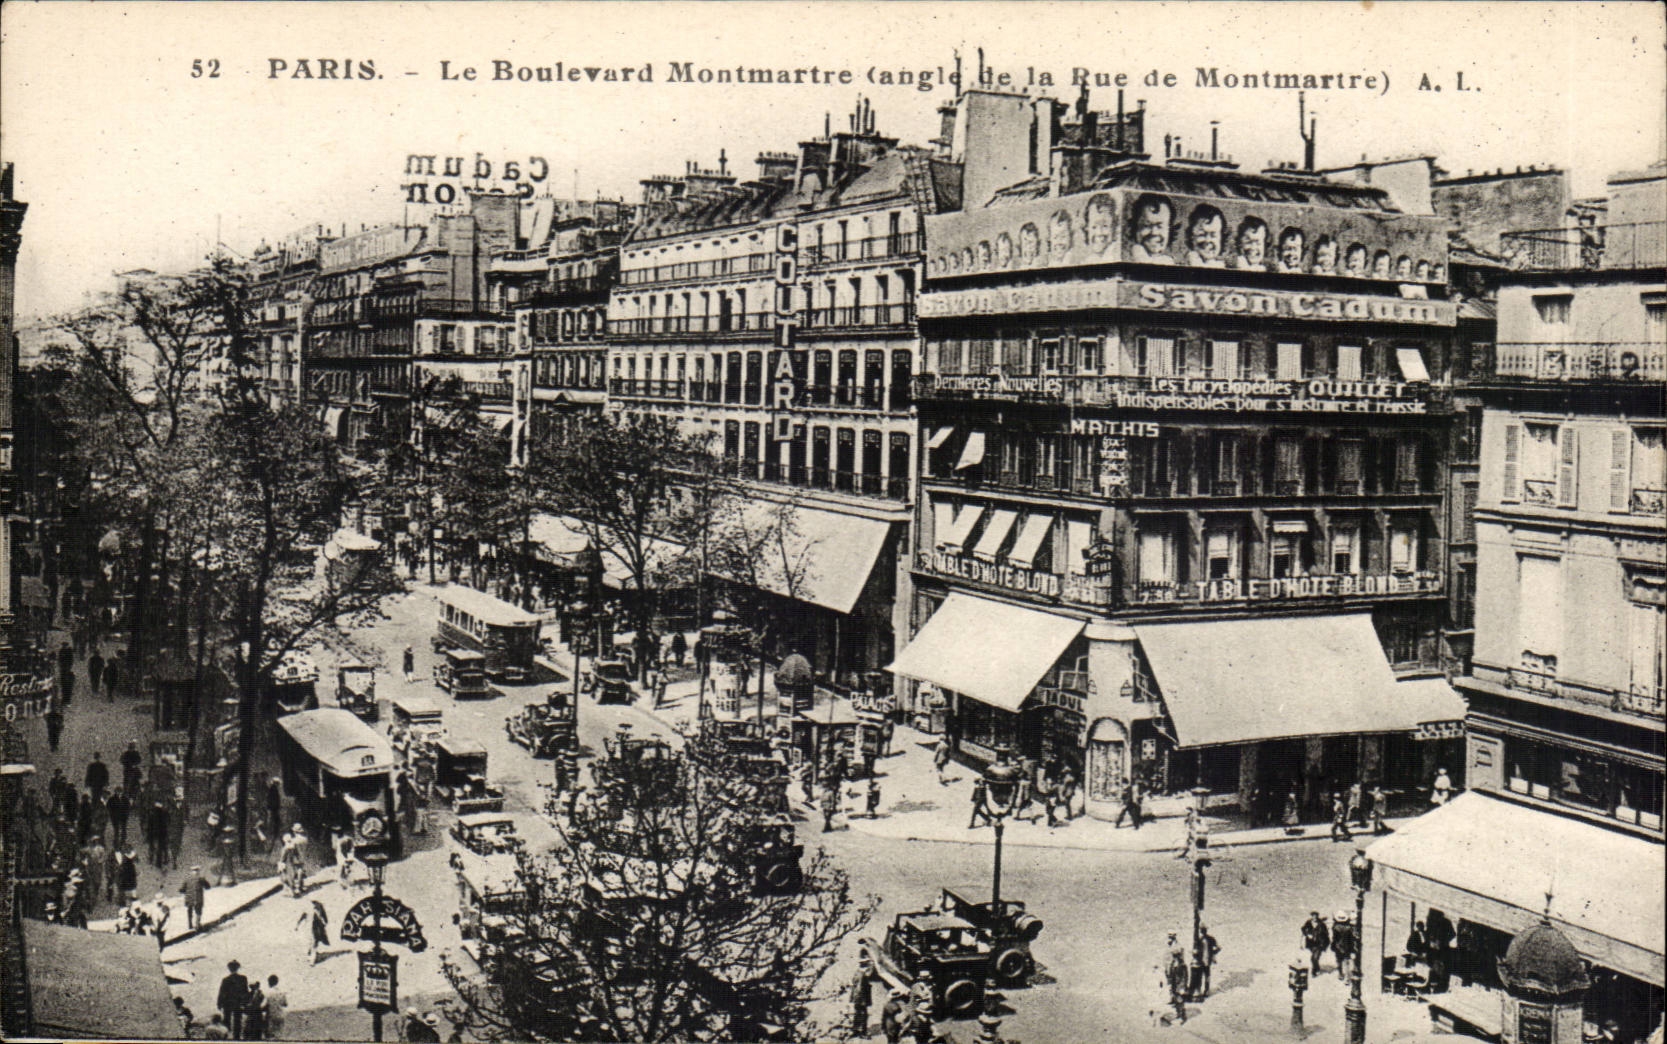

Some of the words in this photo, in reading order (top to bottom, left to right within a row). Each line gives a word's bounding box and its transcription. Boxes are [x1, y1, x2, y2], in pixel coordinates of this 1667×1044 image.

[1139, 283, 1280, 316] Savon
[1289, 293, 1440, 322] Cadum
[773, 223, 799, 441] COUTARD
[1070, 418, 1160, 438] MATHIS
[1196, 578, 1261, 600] TABLE
[1344, 574, 1398, 596] BLOND
